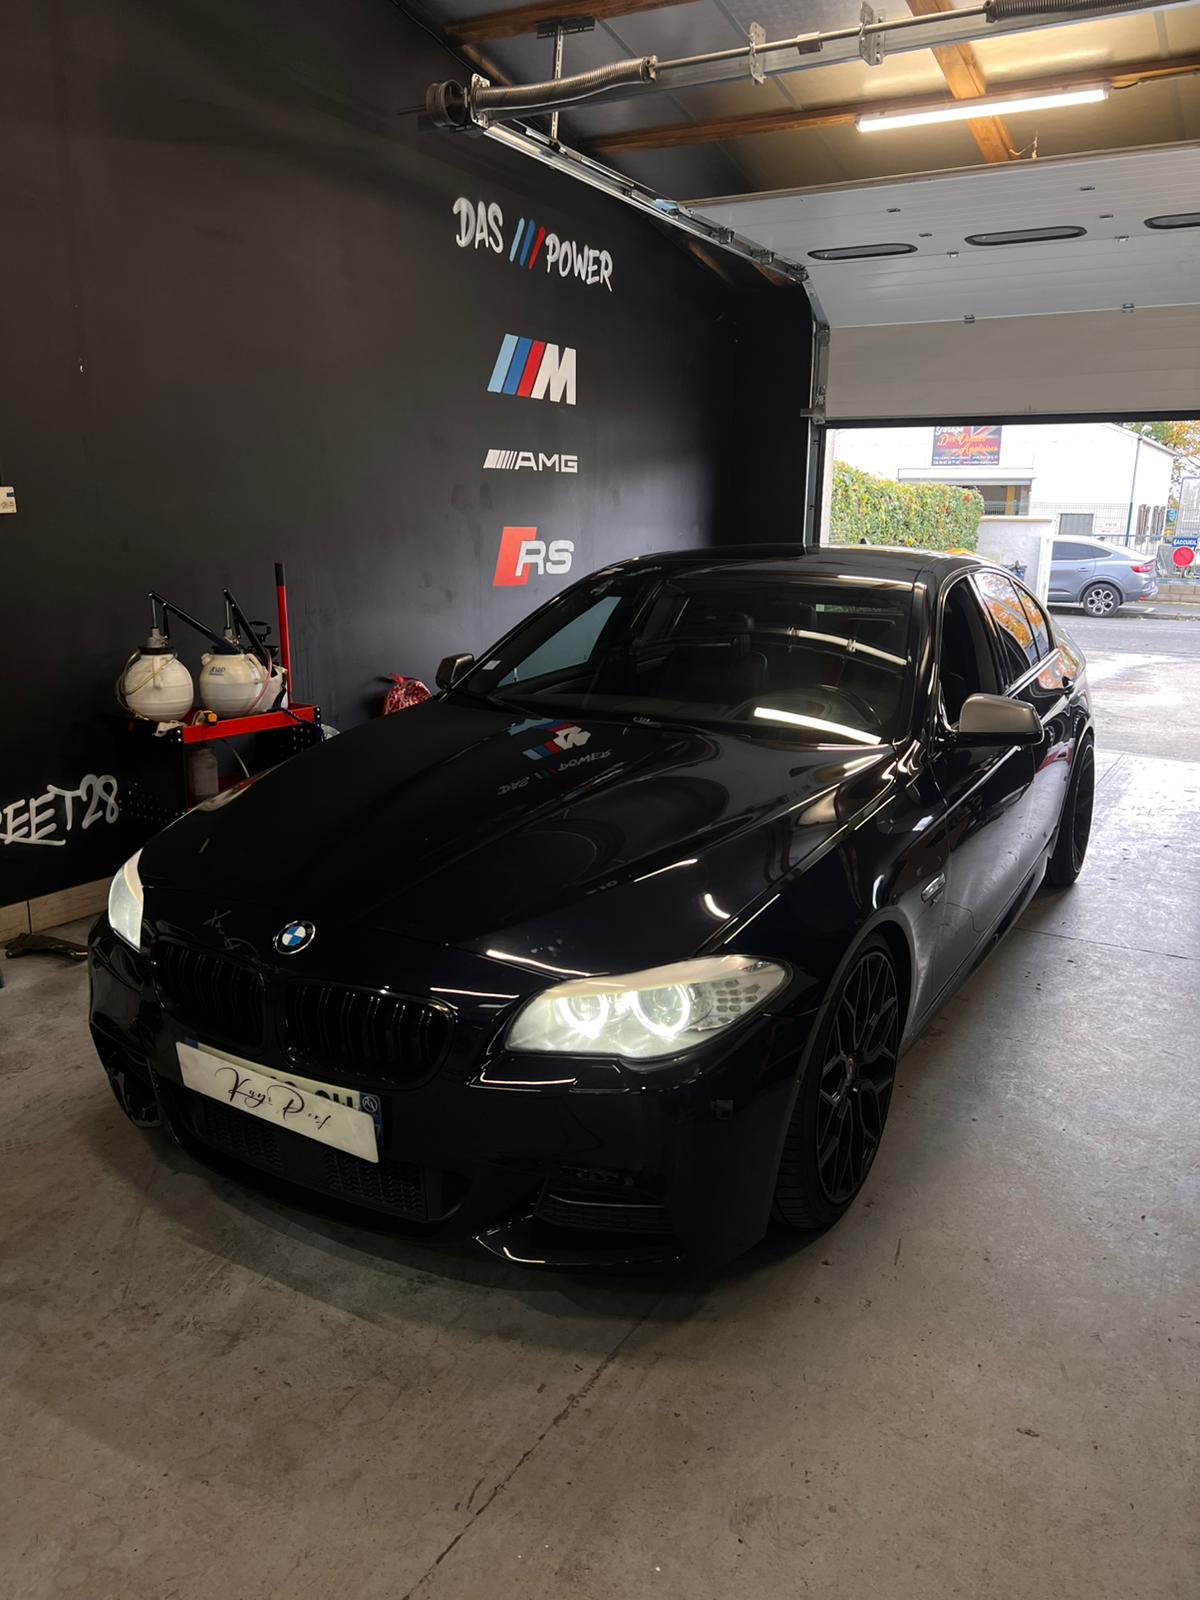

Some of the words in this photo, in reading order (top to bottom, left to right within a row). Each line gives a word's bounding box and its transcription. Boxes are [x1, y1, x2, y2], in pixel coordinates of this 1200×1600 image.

[453, 197, 504, 253] DAS
[545, 233, 613, 292] POWER
[514, 451, 578, 473] AMG
[514, 540, 575, 577] RS
[0, 774, 119, 847] EET28
